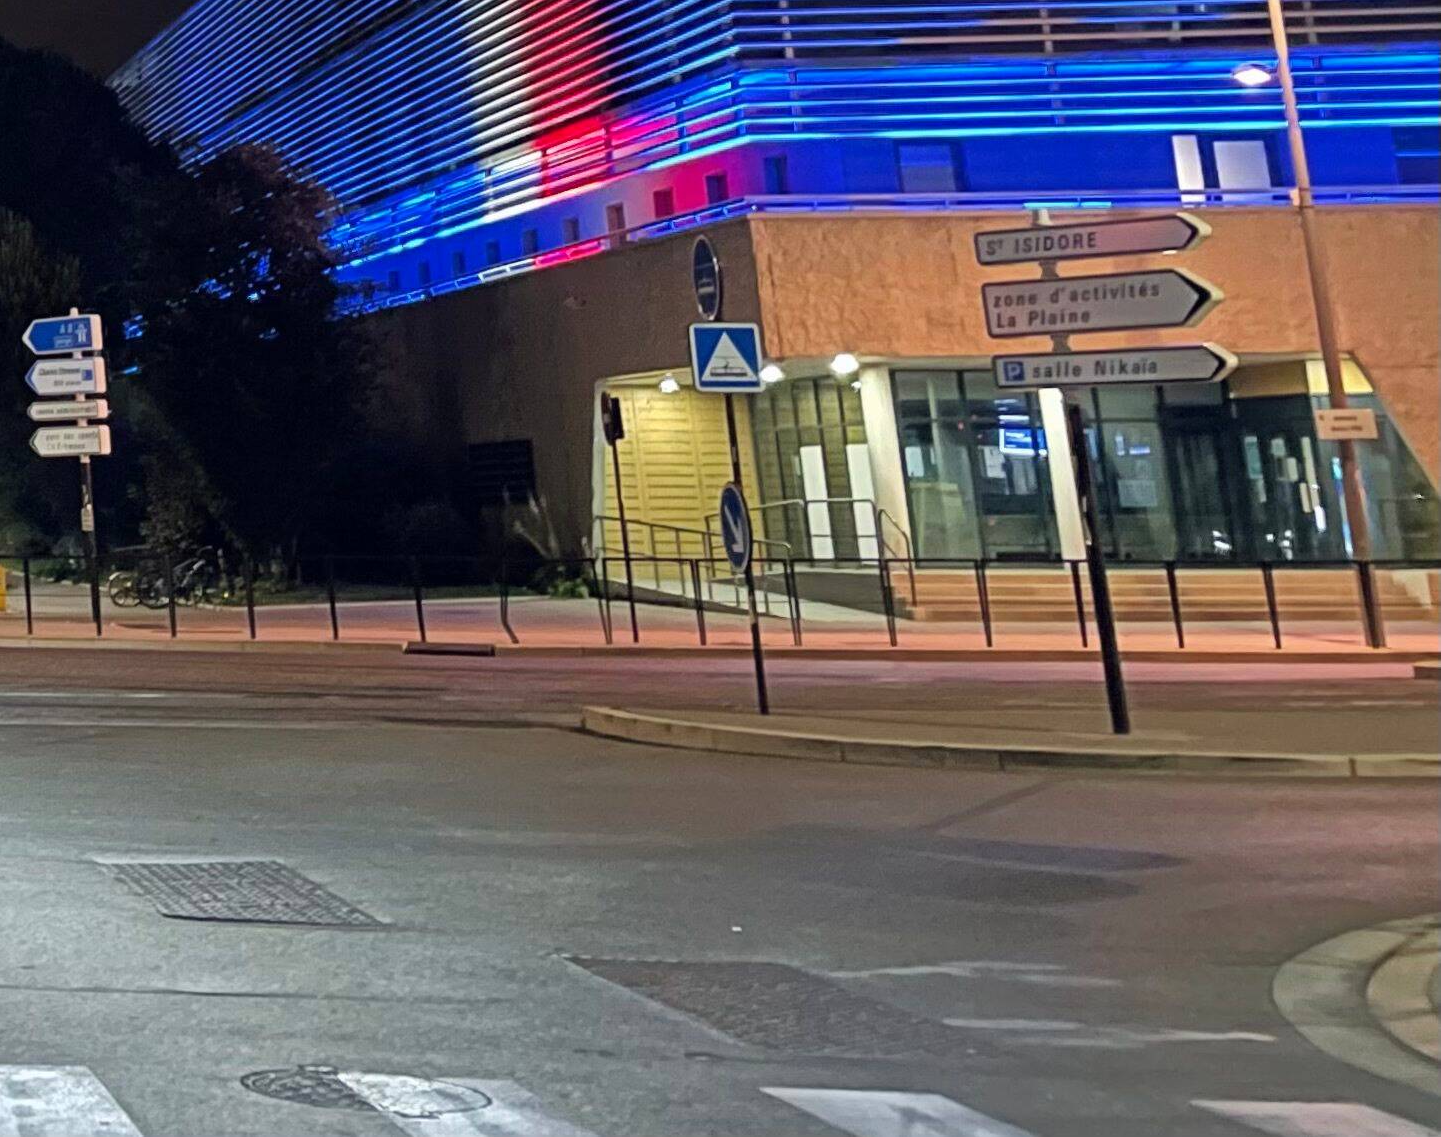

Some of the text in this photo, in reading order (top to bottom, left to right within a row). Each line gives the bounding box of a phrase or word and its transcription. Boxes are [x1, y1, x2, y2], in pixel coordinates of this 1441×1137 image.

[1013, 232, 1097, 254] ISIDORE
[993, 283, 1160, 308] zone d'activités
[996, 311, 1091, 329] La Plaine
[1007, 360, 1158, 380] P salle Nikaïa
